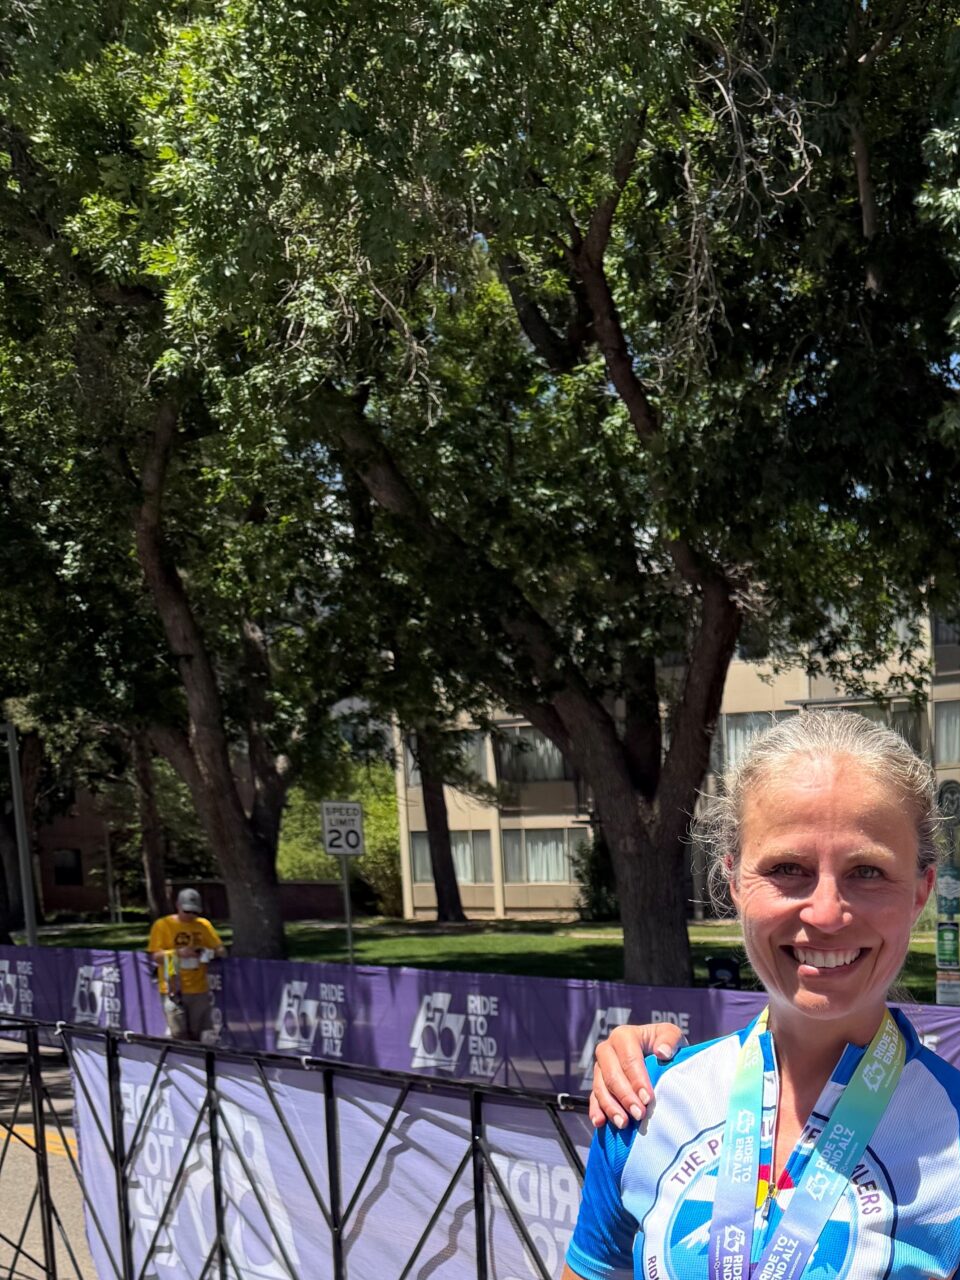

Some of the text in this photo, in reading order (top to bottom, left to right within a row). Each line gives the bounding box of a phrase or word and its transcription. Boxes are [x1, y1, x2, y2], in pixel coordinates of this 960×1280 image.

[326, 807, 360, 816] SPEED
[330, 818, 356, 827] LIMIT
[328, 829, 361, 849] 20
[320, 983, 345, 1002] RIDE
[321, 1002, 337, 1019] TO
[467, 995, 499, 1016] RIDE
[321, 1020, 344, 1039] END
[467, 1016, 487, 1036] TO
[322, 1038, 343, 1057] ALZ
[468, 1036, 497, 1057] END
[872, 1031, 891, 1060] RIDE
[883, 1041, 896, 1065] END
[469, 1056, 495, 1077] ALZ
[815, 1140, 836, 1169] RIDE
[829, 1124, 844, 1141] TO
[826, 1150, 846, 1173] END
[838, 1129, 855, 1152] ALZ
[741, 1136, 754, 1182] RIDE TO
[670, 1150, 706, 1185] THE
[849, 1163, 882, 1215] ALERS
[773, 1235, 788, 1253] TO
[782, 1239, 799, 1261] ALZ
[723, 1255, 732, 1280] END
